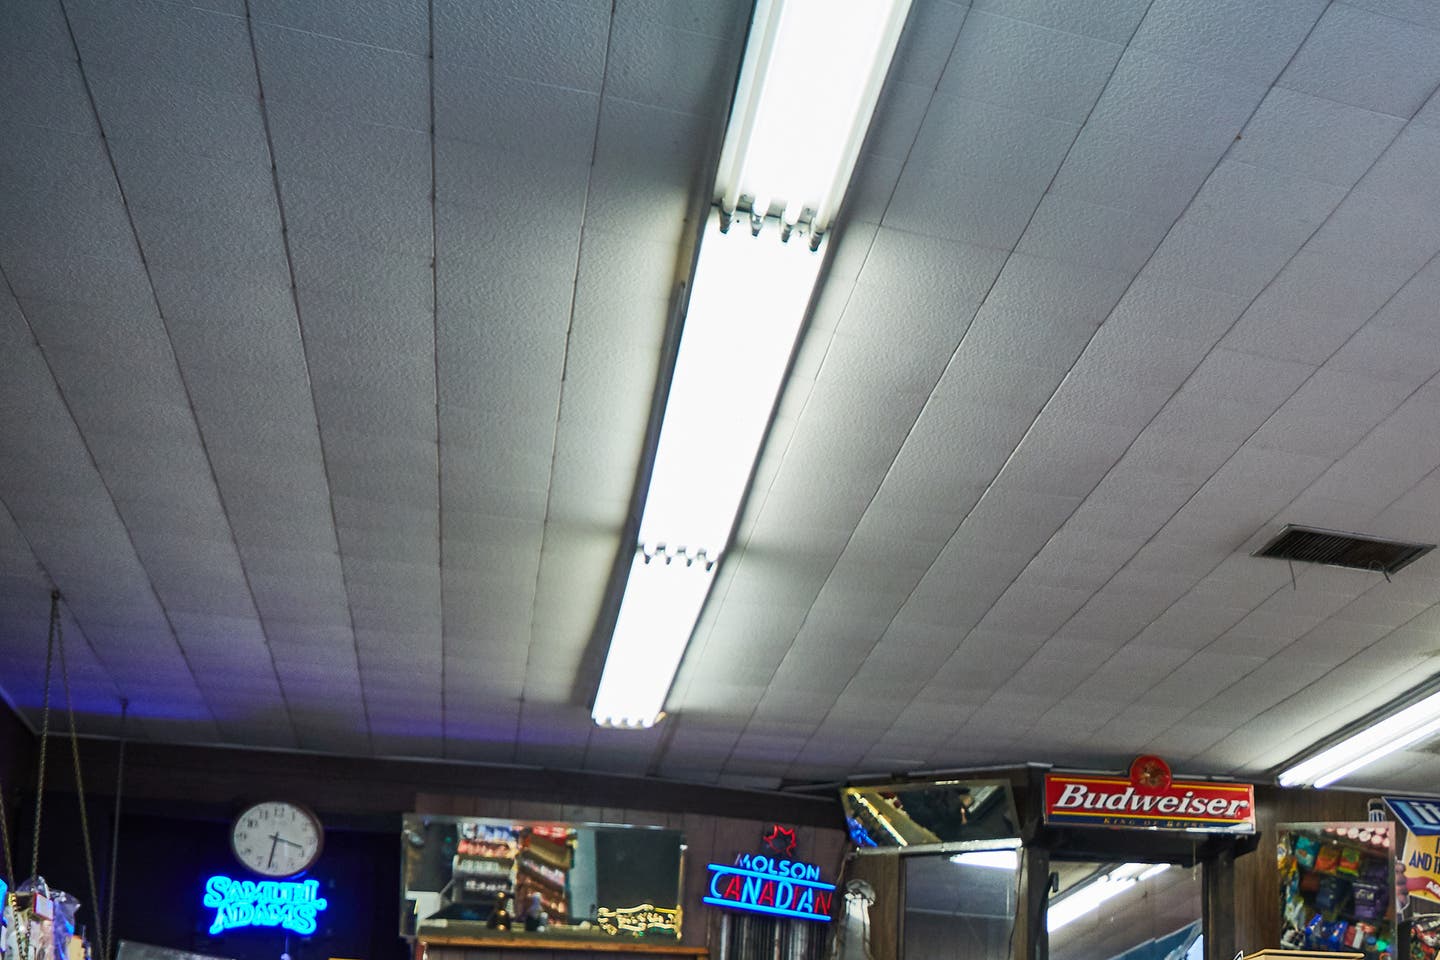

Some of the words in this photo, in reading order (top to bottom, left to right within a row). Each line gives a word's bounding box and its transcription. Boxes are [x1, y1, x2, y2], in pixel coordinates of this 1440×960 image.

[1054, 783, 1249, 818] Budweiser
[736, 853, 820, 881] MOLSON
[1409, 852, 1433, 872] AND
[710, 871, 832, 915] CANADIAN
